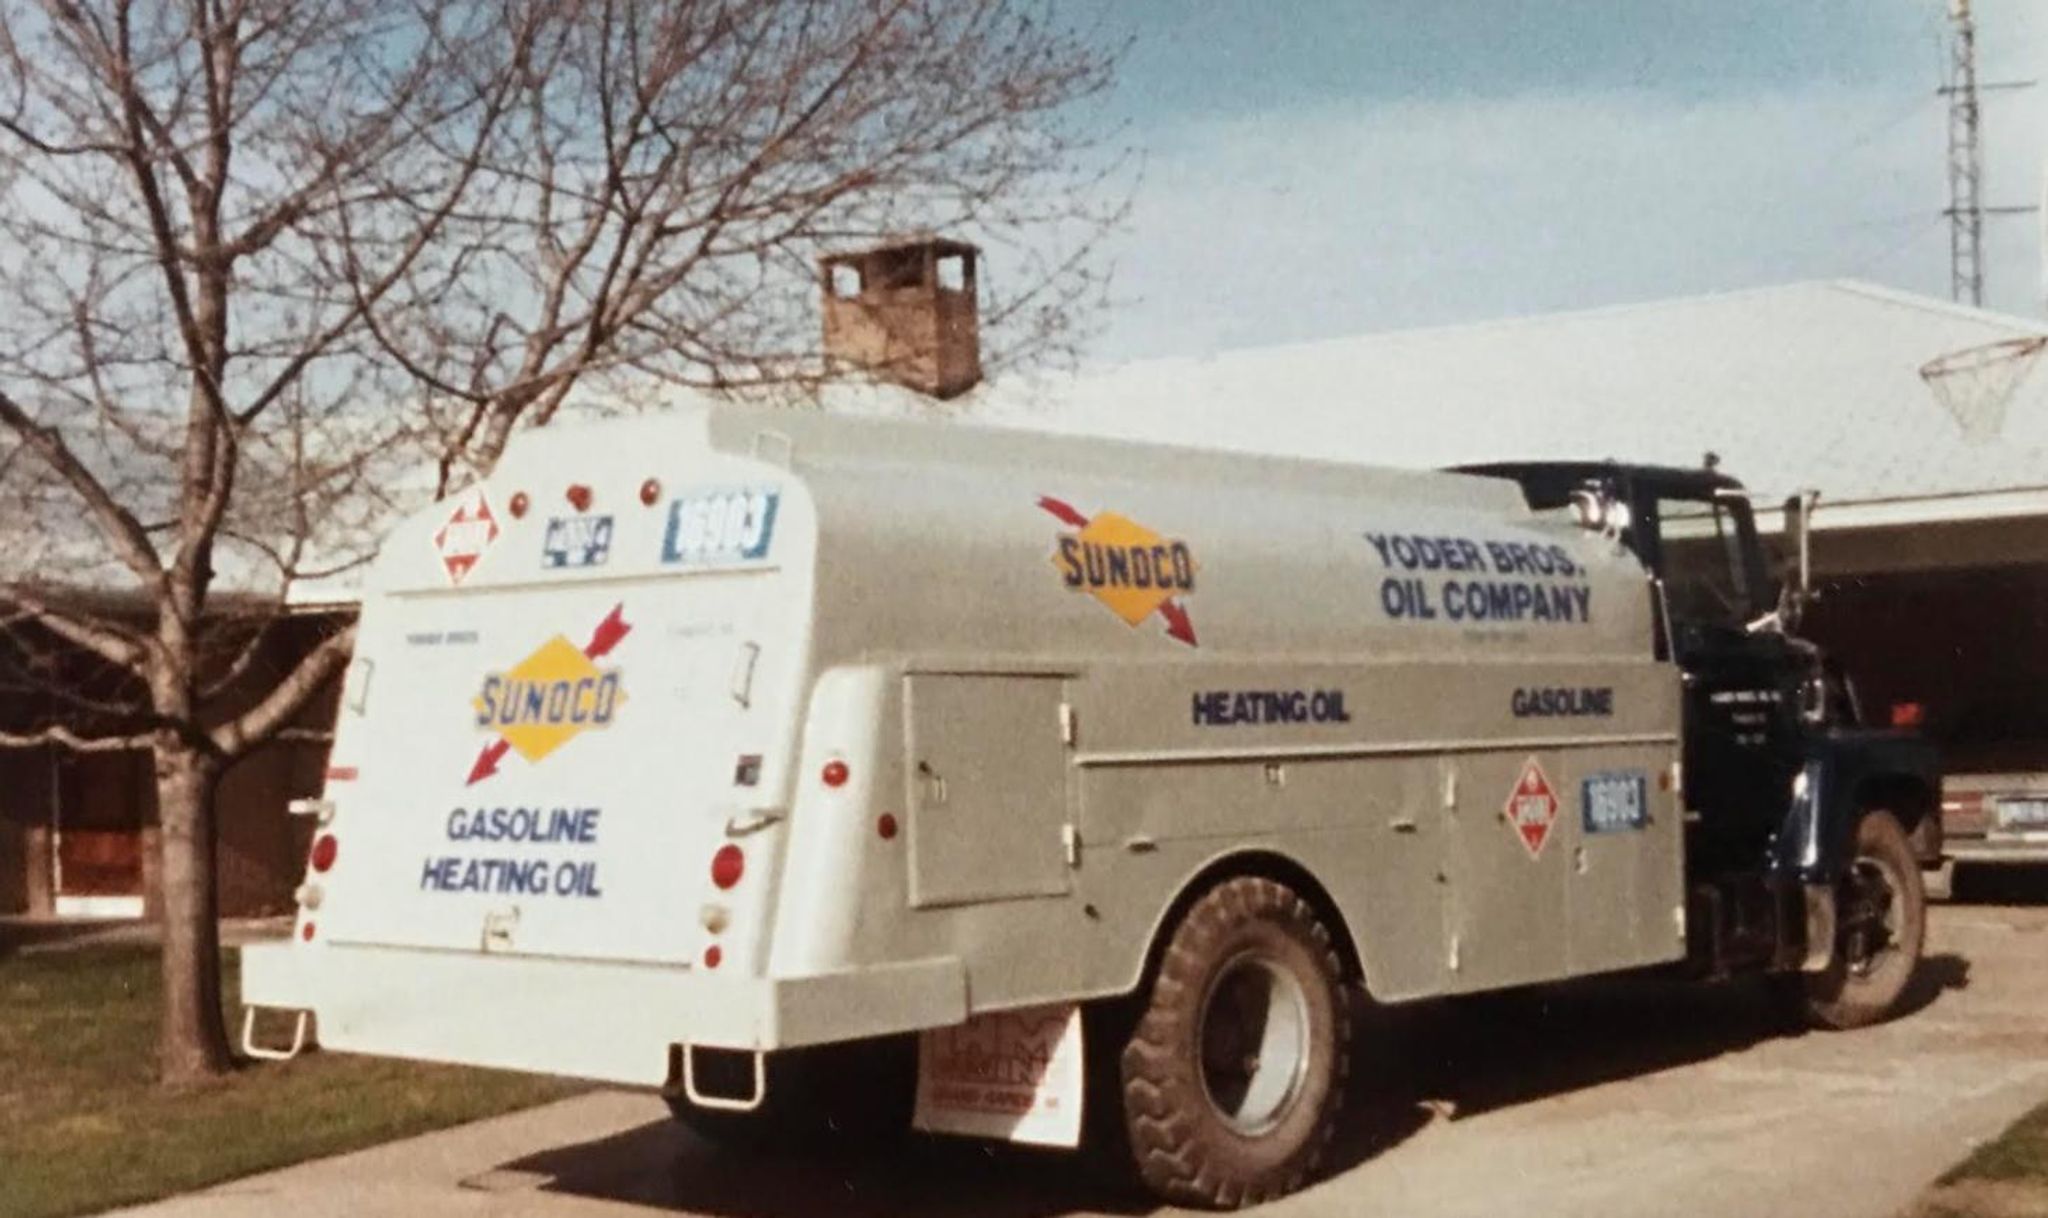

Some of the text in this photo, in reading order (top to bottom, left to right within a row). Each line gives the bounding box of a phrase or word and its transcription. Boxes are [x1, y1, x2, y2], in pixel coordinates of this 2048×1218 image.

[1060, 536, 1193, 590] SUNOCO
[1364, 531, 1587, 577] YODER BROS.
[1381, 578, 1591, 623] OIL COMPANY
[476, 670, 619, 726] SUNOCO
[1192, 690, 1351, 725] HEATING OIL
[1511, 687, 1614, 717] GASOLINE
[446, 808, 600, 842] GASOLINE
[420, 857, 602, 897] HEATING OIL
